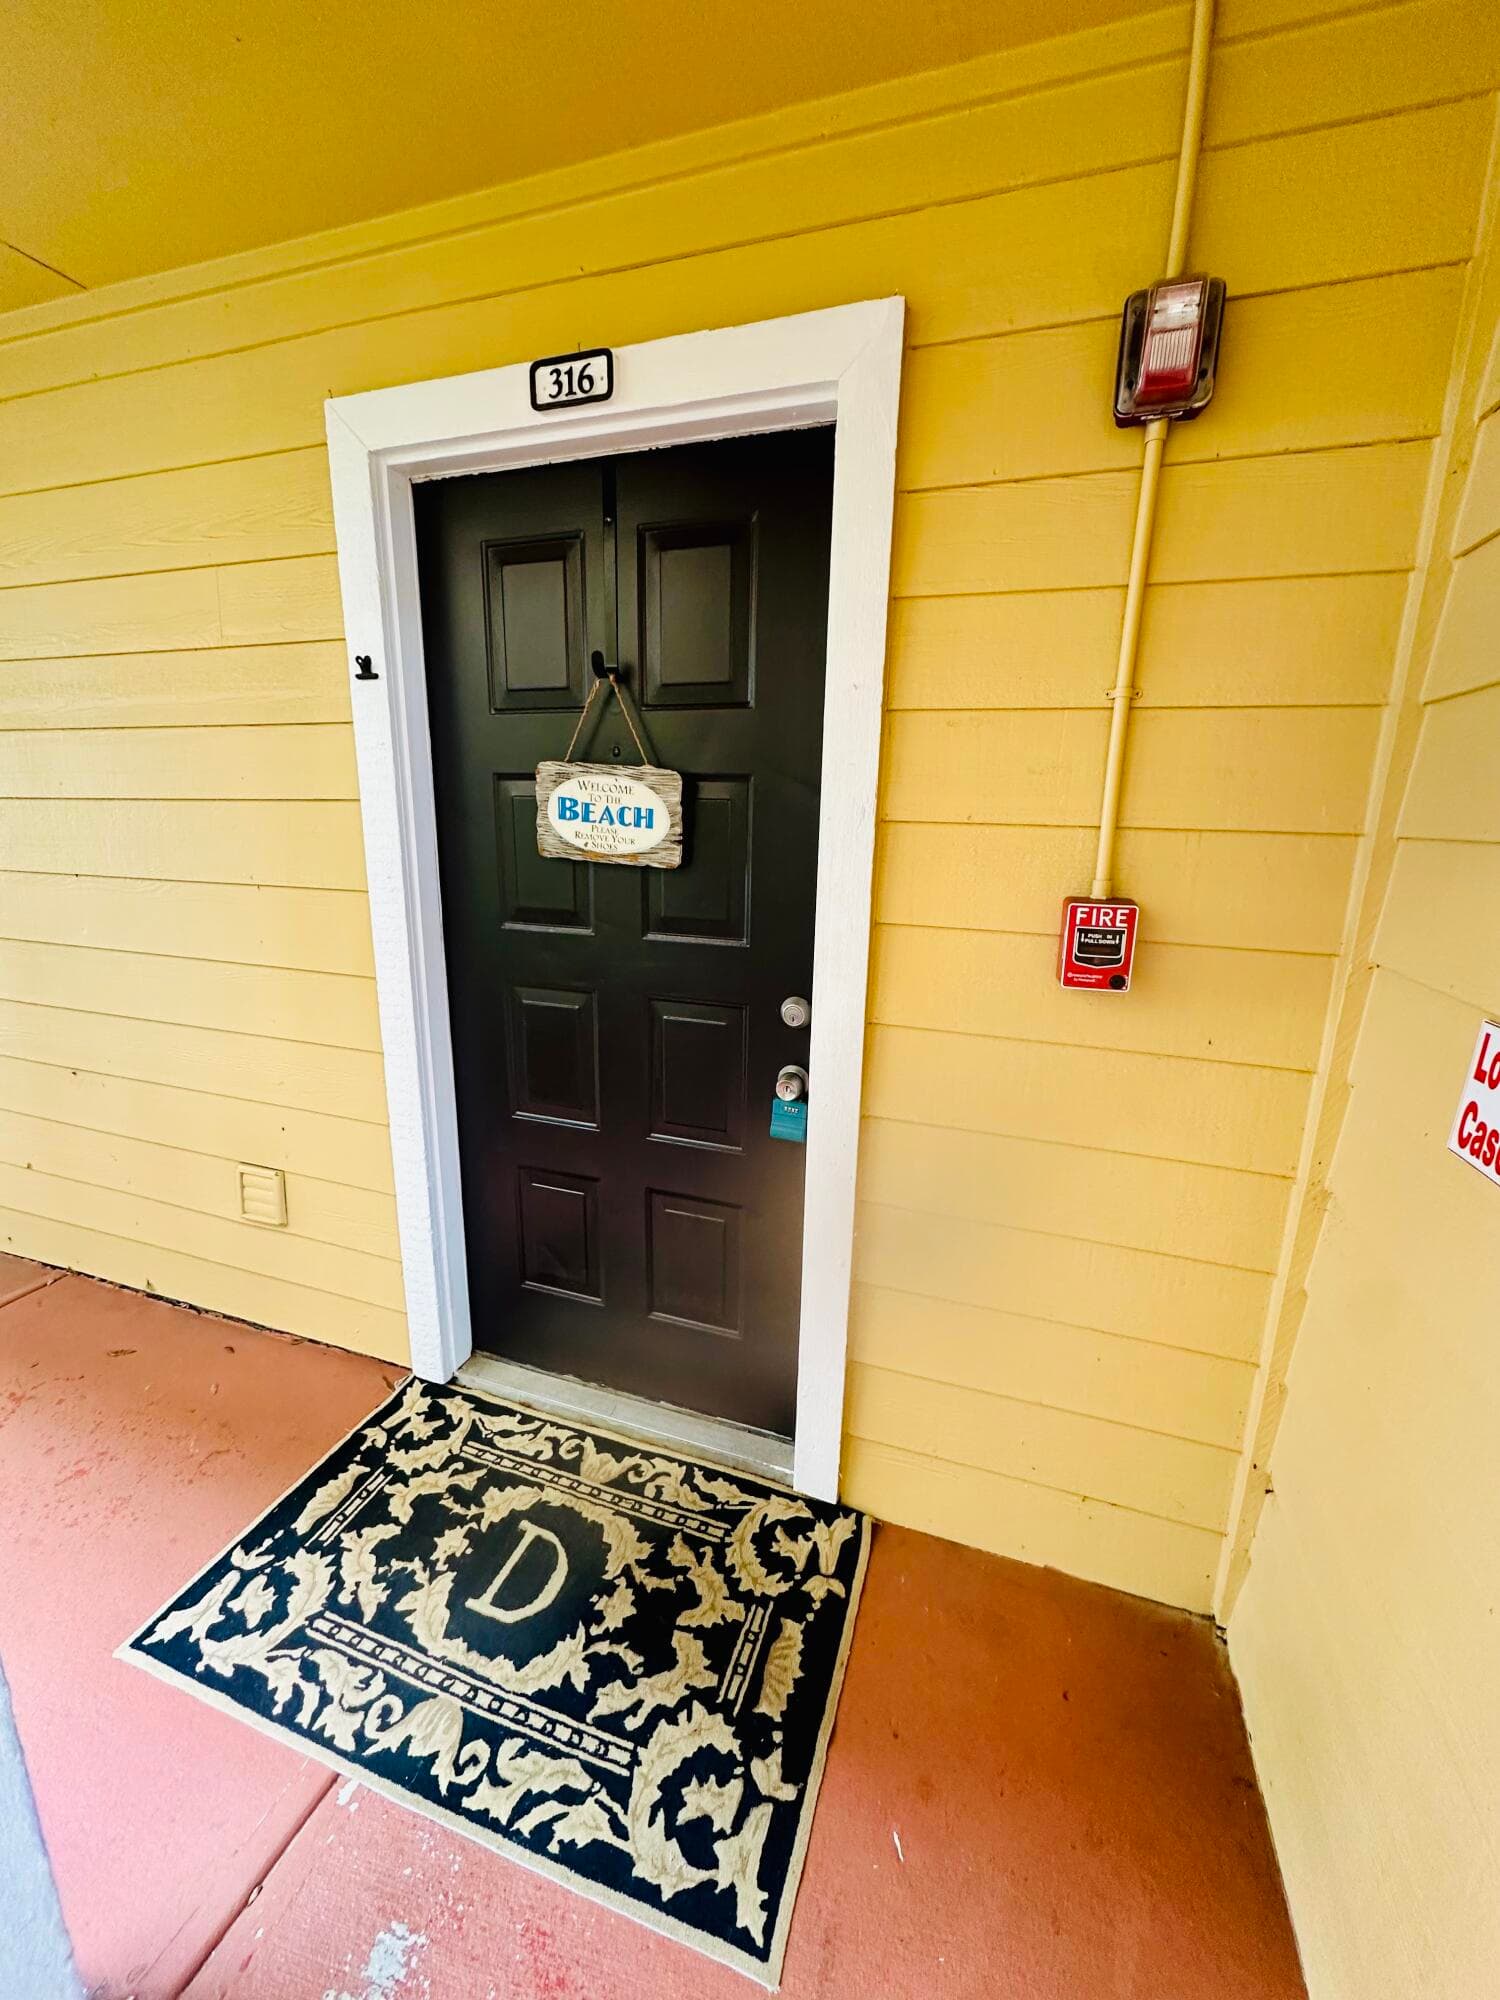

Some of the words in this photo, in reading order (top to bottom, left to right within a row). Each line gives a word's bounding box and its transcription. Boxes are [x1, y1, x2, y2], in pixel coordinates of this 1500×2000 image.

[549, 362, 594, 399] 316
[577, 780, 634, 795] WELCOME
[589, 794, 602, 802] TO
[605, 794, 622, 804] THE
[558, 796, 654, 829] BEACH
[575, 831, 608, 842] REMOVE
[610, 834, 636, 845] YOUR
[591, 825, 618, 835] PLEASE
[1076, 907, 1130, 927] FIRE
[465, 1520, 568, 1623] D
